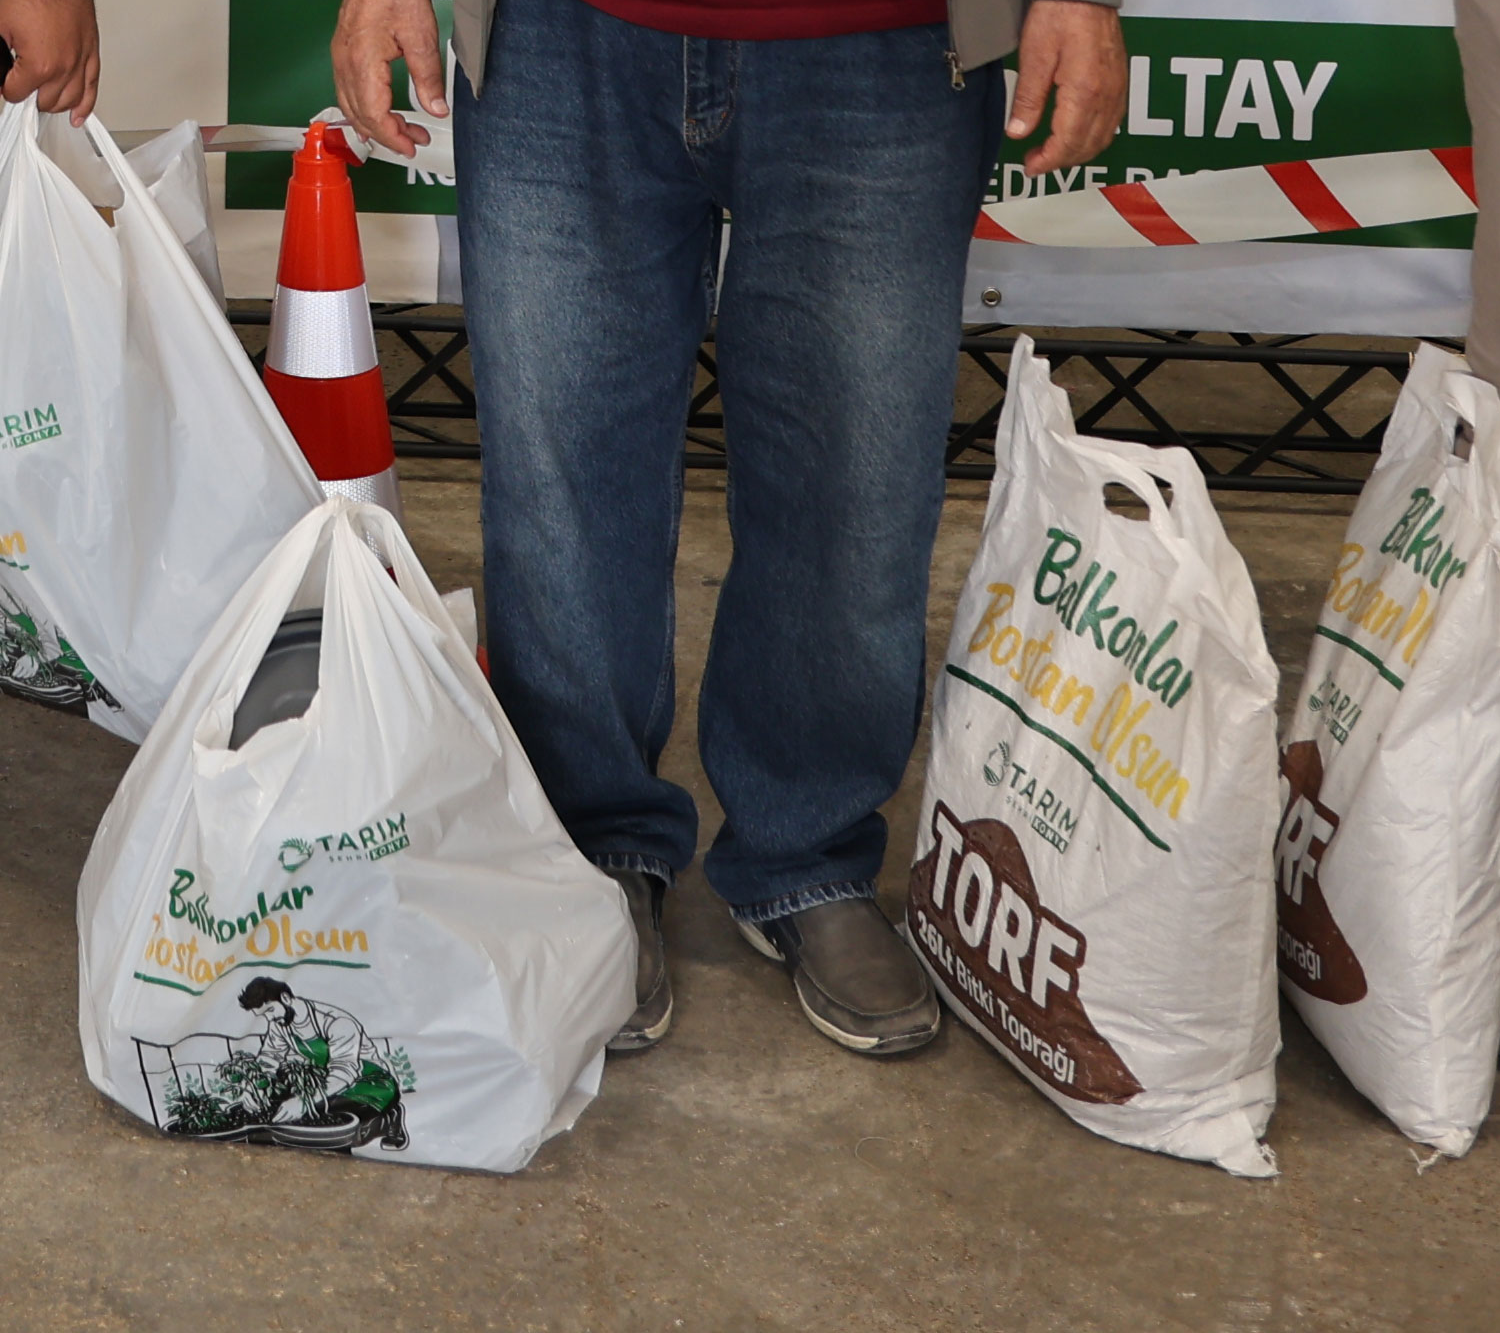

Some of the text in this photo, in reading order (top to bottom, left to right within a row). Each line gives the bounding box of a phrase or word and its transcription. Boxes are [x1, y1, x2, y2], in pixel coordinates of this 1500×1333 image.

[1113, 55, 1339, 142] LTAY
[14, 425, 61, 448] KONYA
[967, 582, 1191, 821] Bostan Olsun
[315, 812, 407, 853] TARIM
[1008, 762, 1080, 834] TARIM
[369, 834, 411, 862] KONYA
[1275, 783, 1336, 906] RF
[245, 914, 369, 957] Olsun
[931, 810, 1079, 1009] TORF
[916, 910, 1076, 1085] 26Lt Bitki Toprağı
